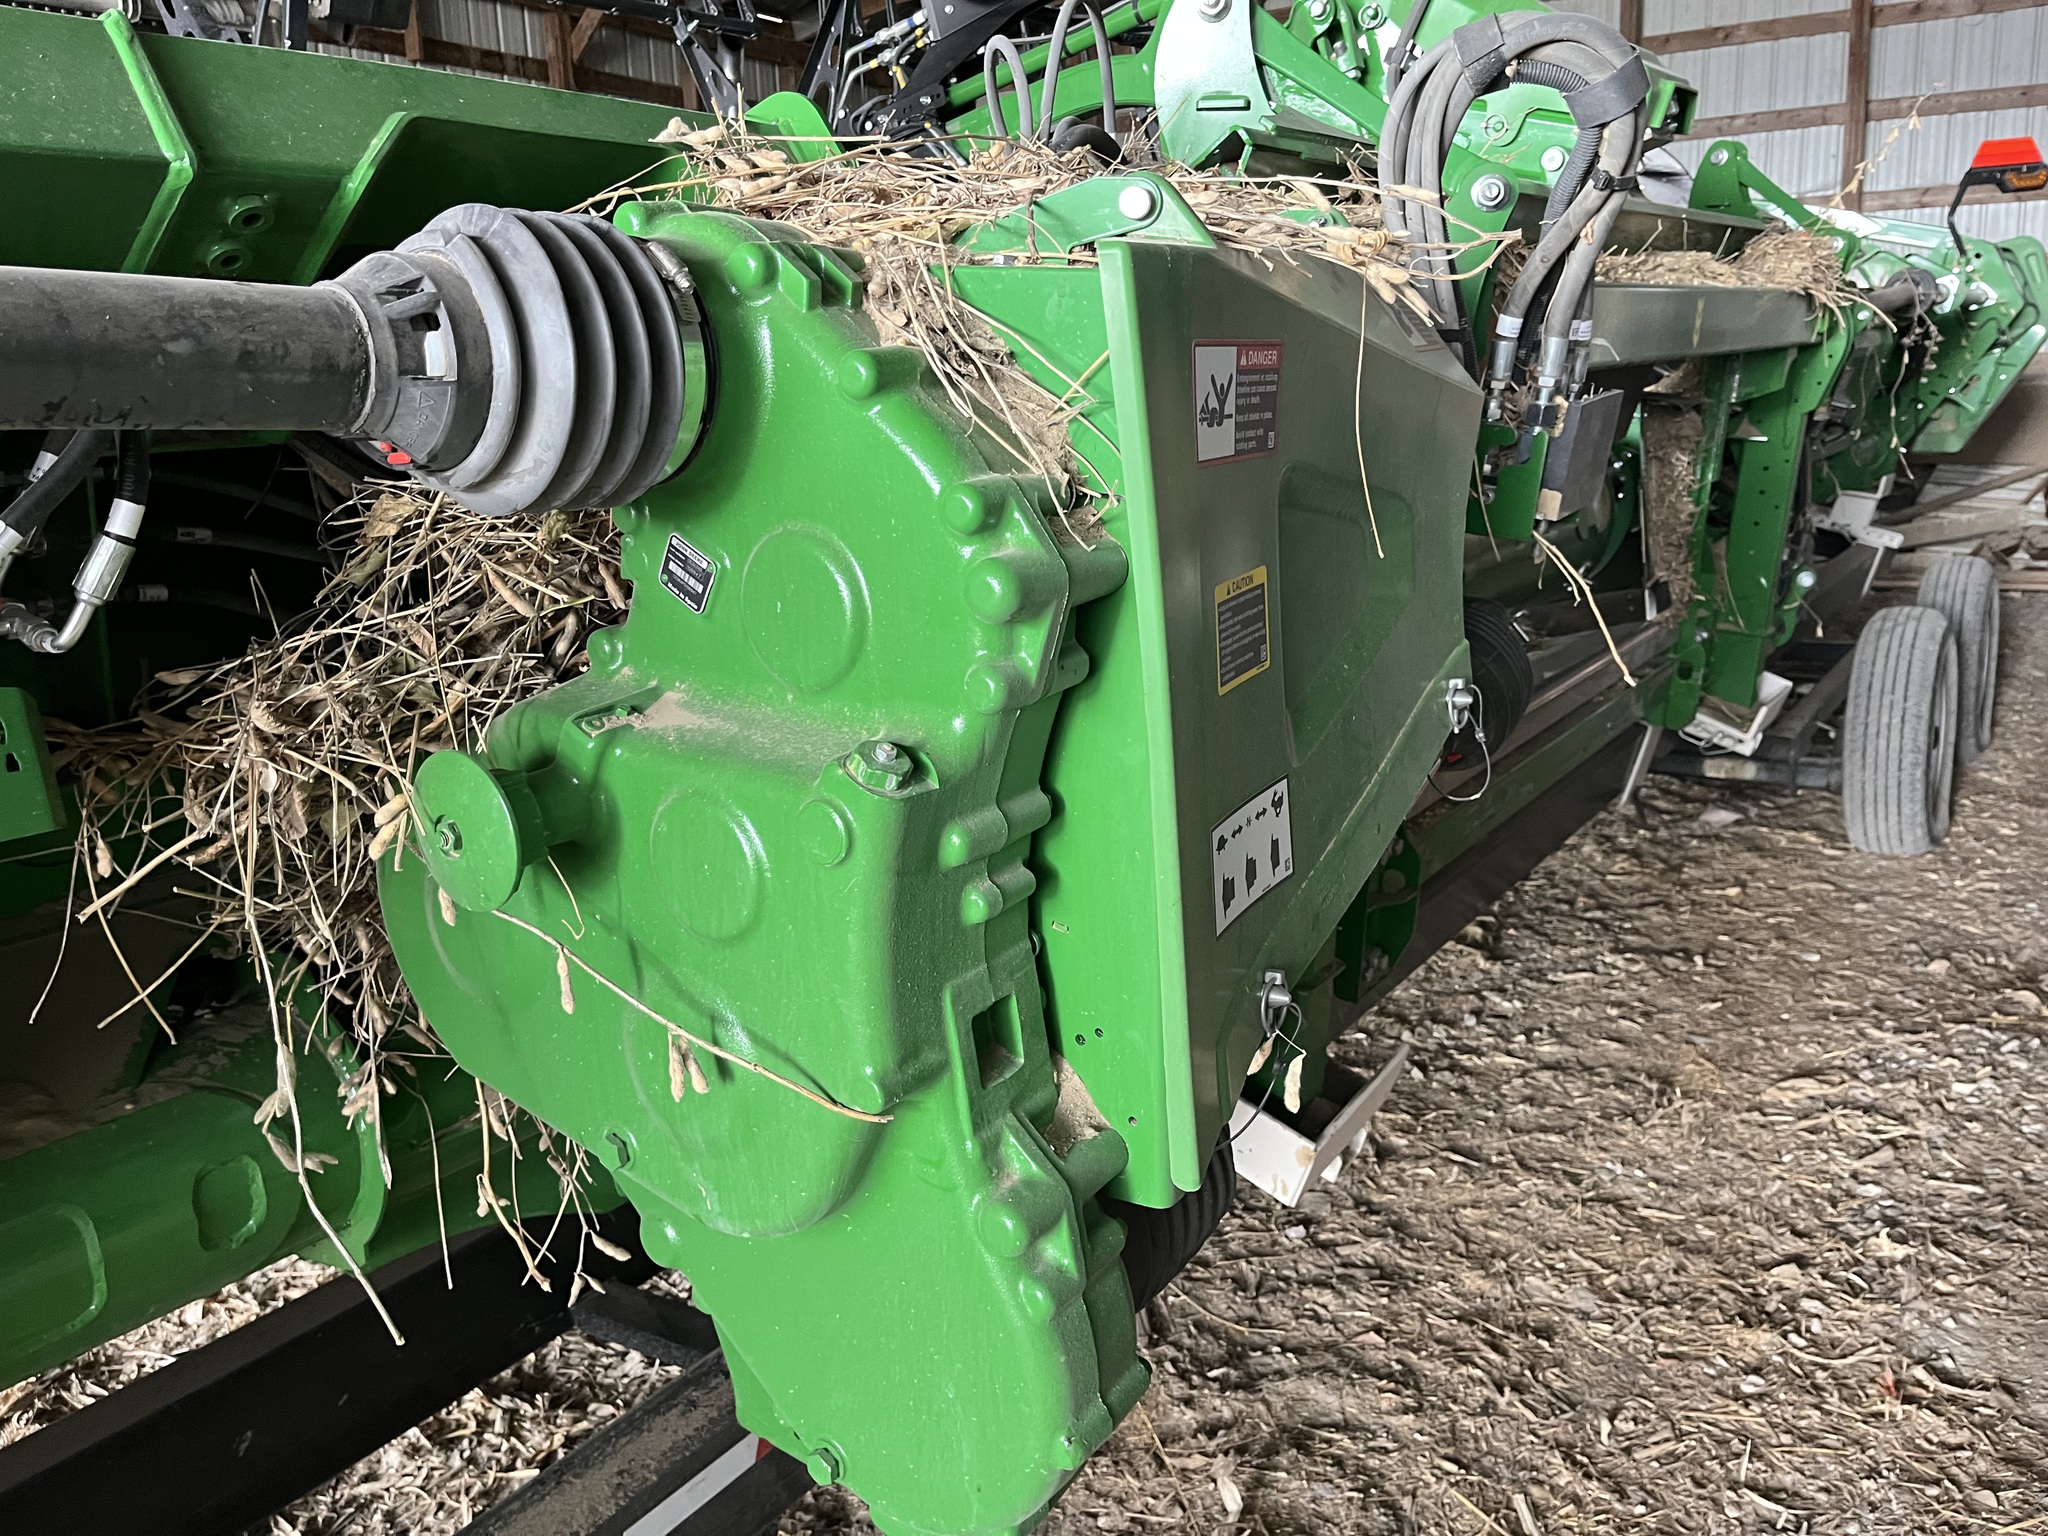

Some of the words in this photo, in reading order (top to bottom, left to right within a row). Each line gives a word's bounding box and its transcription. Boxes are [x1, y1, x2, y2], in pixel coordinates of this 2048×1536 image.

[1249, 351, 1278, 365] DANGER
[405, 412, 428, 448] DANGER
[676, 542, 688, 553] JOHN
[688, 549, 704, 565] DEERE
[1232, 574, 1254, 593] CAUTION
